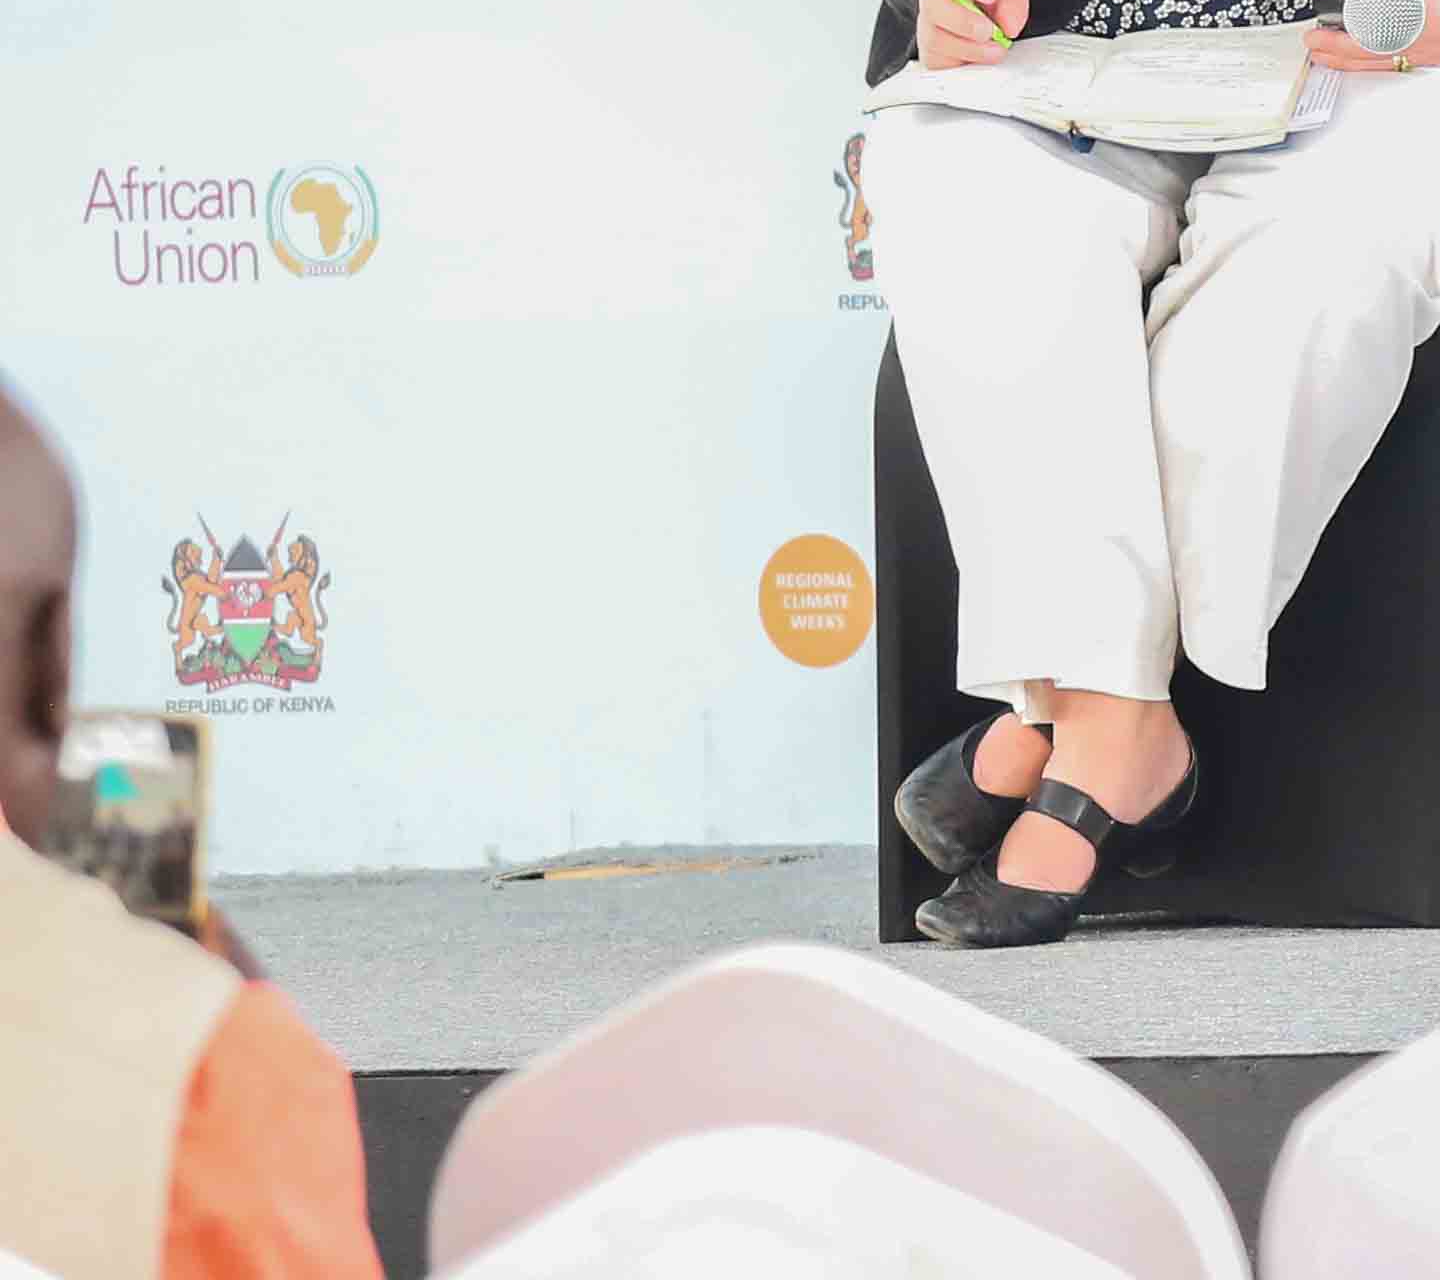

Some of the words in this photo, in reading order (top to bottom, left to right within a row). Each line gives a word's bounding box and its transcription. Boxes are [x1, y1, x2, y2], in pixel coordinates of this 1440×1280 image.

[83, 166, 256, 225] African
[112, 229, 260, 286] Union
[776, 571, 854, 590] REGIONAL
[783, 591, 849, 610] CLIMATE
[791, 614, 846, 632] WEEKS
[166, 698, 248, 714] REPUBLIC
[253, 697, 274, 713] OF
[279, 695, 336, 713] KENYA
